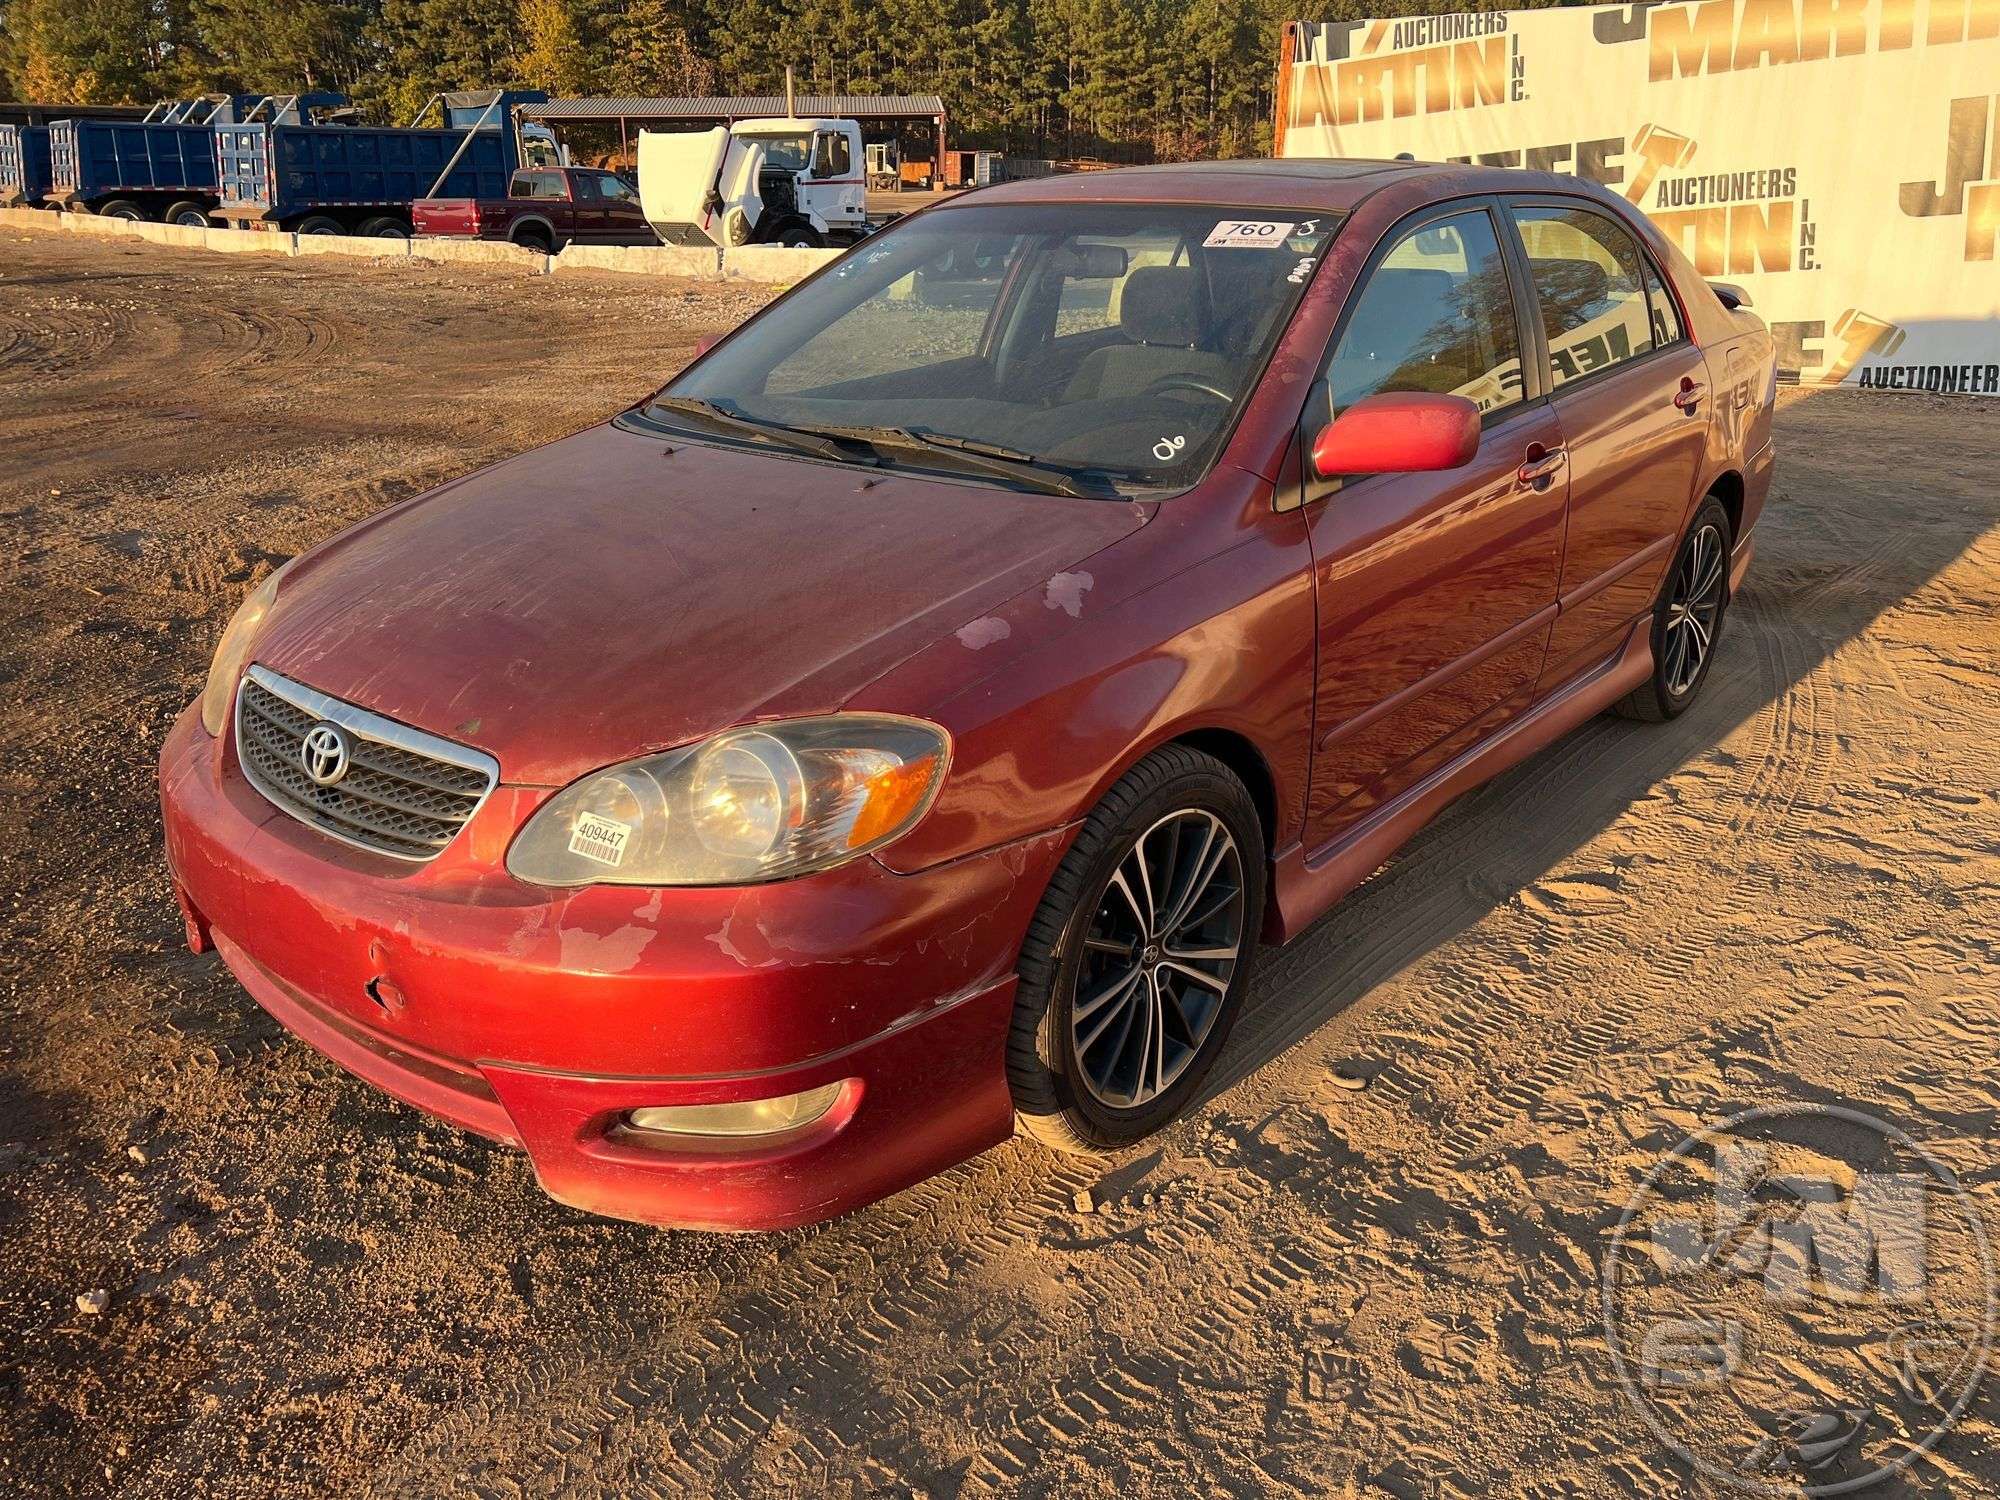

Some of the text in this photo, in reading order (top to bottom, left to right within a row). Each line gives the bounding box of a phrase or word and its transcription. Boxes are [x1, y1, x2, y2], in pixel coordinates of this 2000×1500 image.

[1393, 12, 1507, 50] AUCTIONEERS
[1287, 36, 1505, 128] ARTIN
[1511, 34, 1530, 101] INC.
[1656, 167, 1796, 208] AUCTIONEERS
[1226, 223, 1276, 236] 760
[1800, 199, 1821, 271] INC.
[1859, 364, 2000, 393] AUCTIONEER
[1152, 435, 1185, 460] 06
[578, 822, 624, 847] 409447
